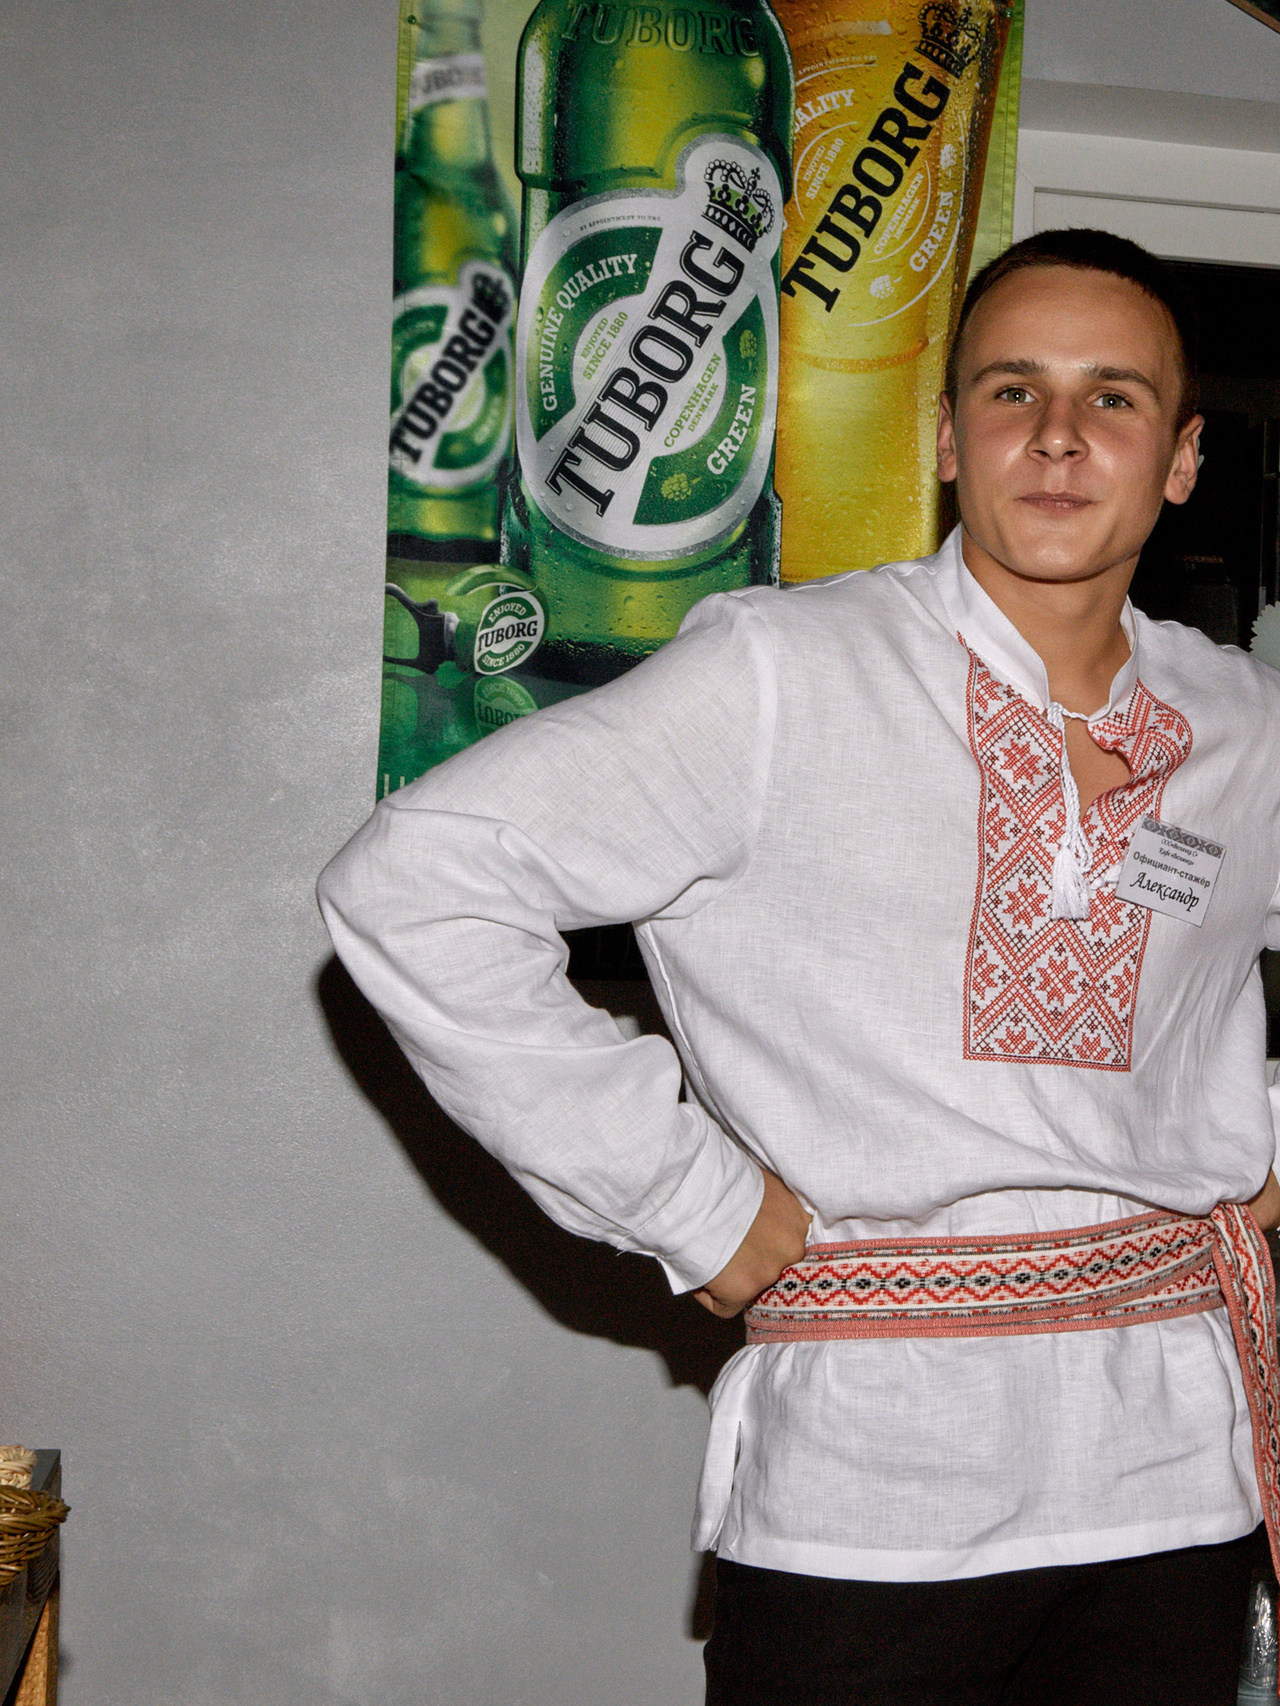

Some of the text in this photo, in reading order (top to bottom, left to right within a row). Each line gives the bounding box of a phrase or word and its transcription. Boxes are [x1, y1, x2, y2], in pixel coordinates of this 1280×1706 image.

[560, 0, 761, 57] TUBORG
[780, 61, 951, 314] TUBORG
[805, 136, 846, 201] SINCE 1880
[873, 171, 925, 256] COPENHAGEN
[909, 190, 954, 272] GREEN
[540, 253, 638, 413] GENUINE QUALITY
[580, 316, 609, 360] ENJOYED
[582, 310, 629, 381] SINCE 1880
[389, 307, 497, 465] TUBORG
[544, 229, 746, 518] TUBORG
[663, 352, 722, 448] COPENHAGEN
[687, 382, 719, 433] DENMARK
[706, 383, 757, 475] GREEN
[477, 619, 538, 653] TUBORG
[488, 601, 527, 624] ENJOYED
[481, 643, 526, 669] SINCE 1880
[1129, 871, 1200, 912] Александр
[1132, 850, 1212, 889] Официант-стажёр
